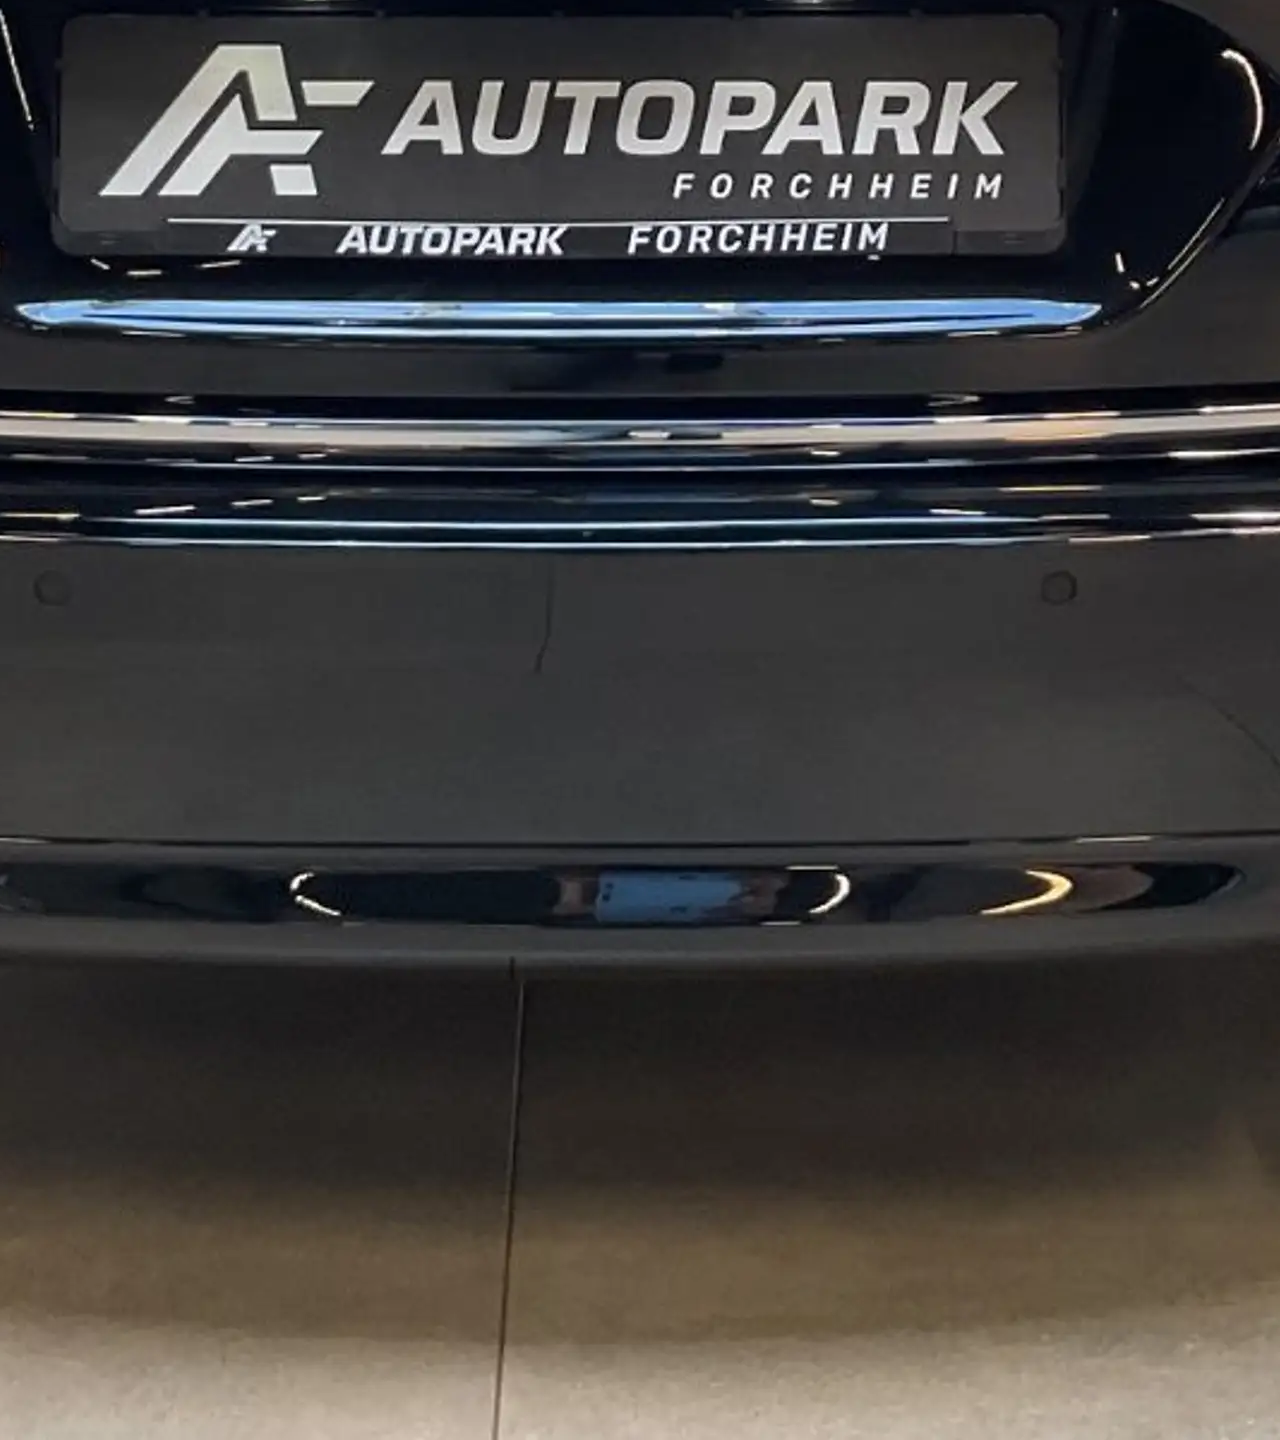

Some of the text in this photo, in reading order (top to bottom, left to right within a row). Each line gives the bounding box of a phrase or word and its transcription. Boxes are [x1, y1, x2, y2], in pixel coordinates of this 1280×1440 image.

[381, 80, 1018, 156] AUTOPARK
[672, 172, 1004, 200] FORCHHEIM
[336, 226, 569, 256] AUTOPARK
[627, 222, 889, 255] FORCHHEIM
